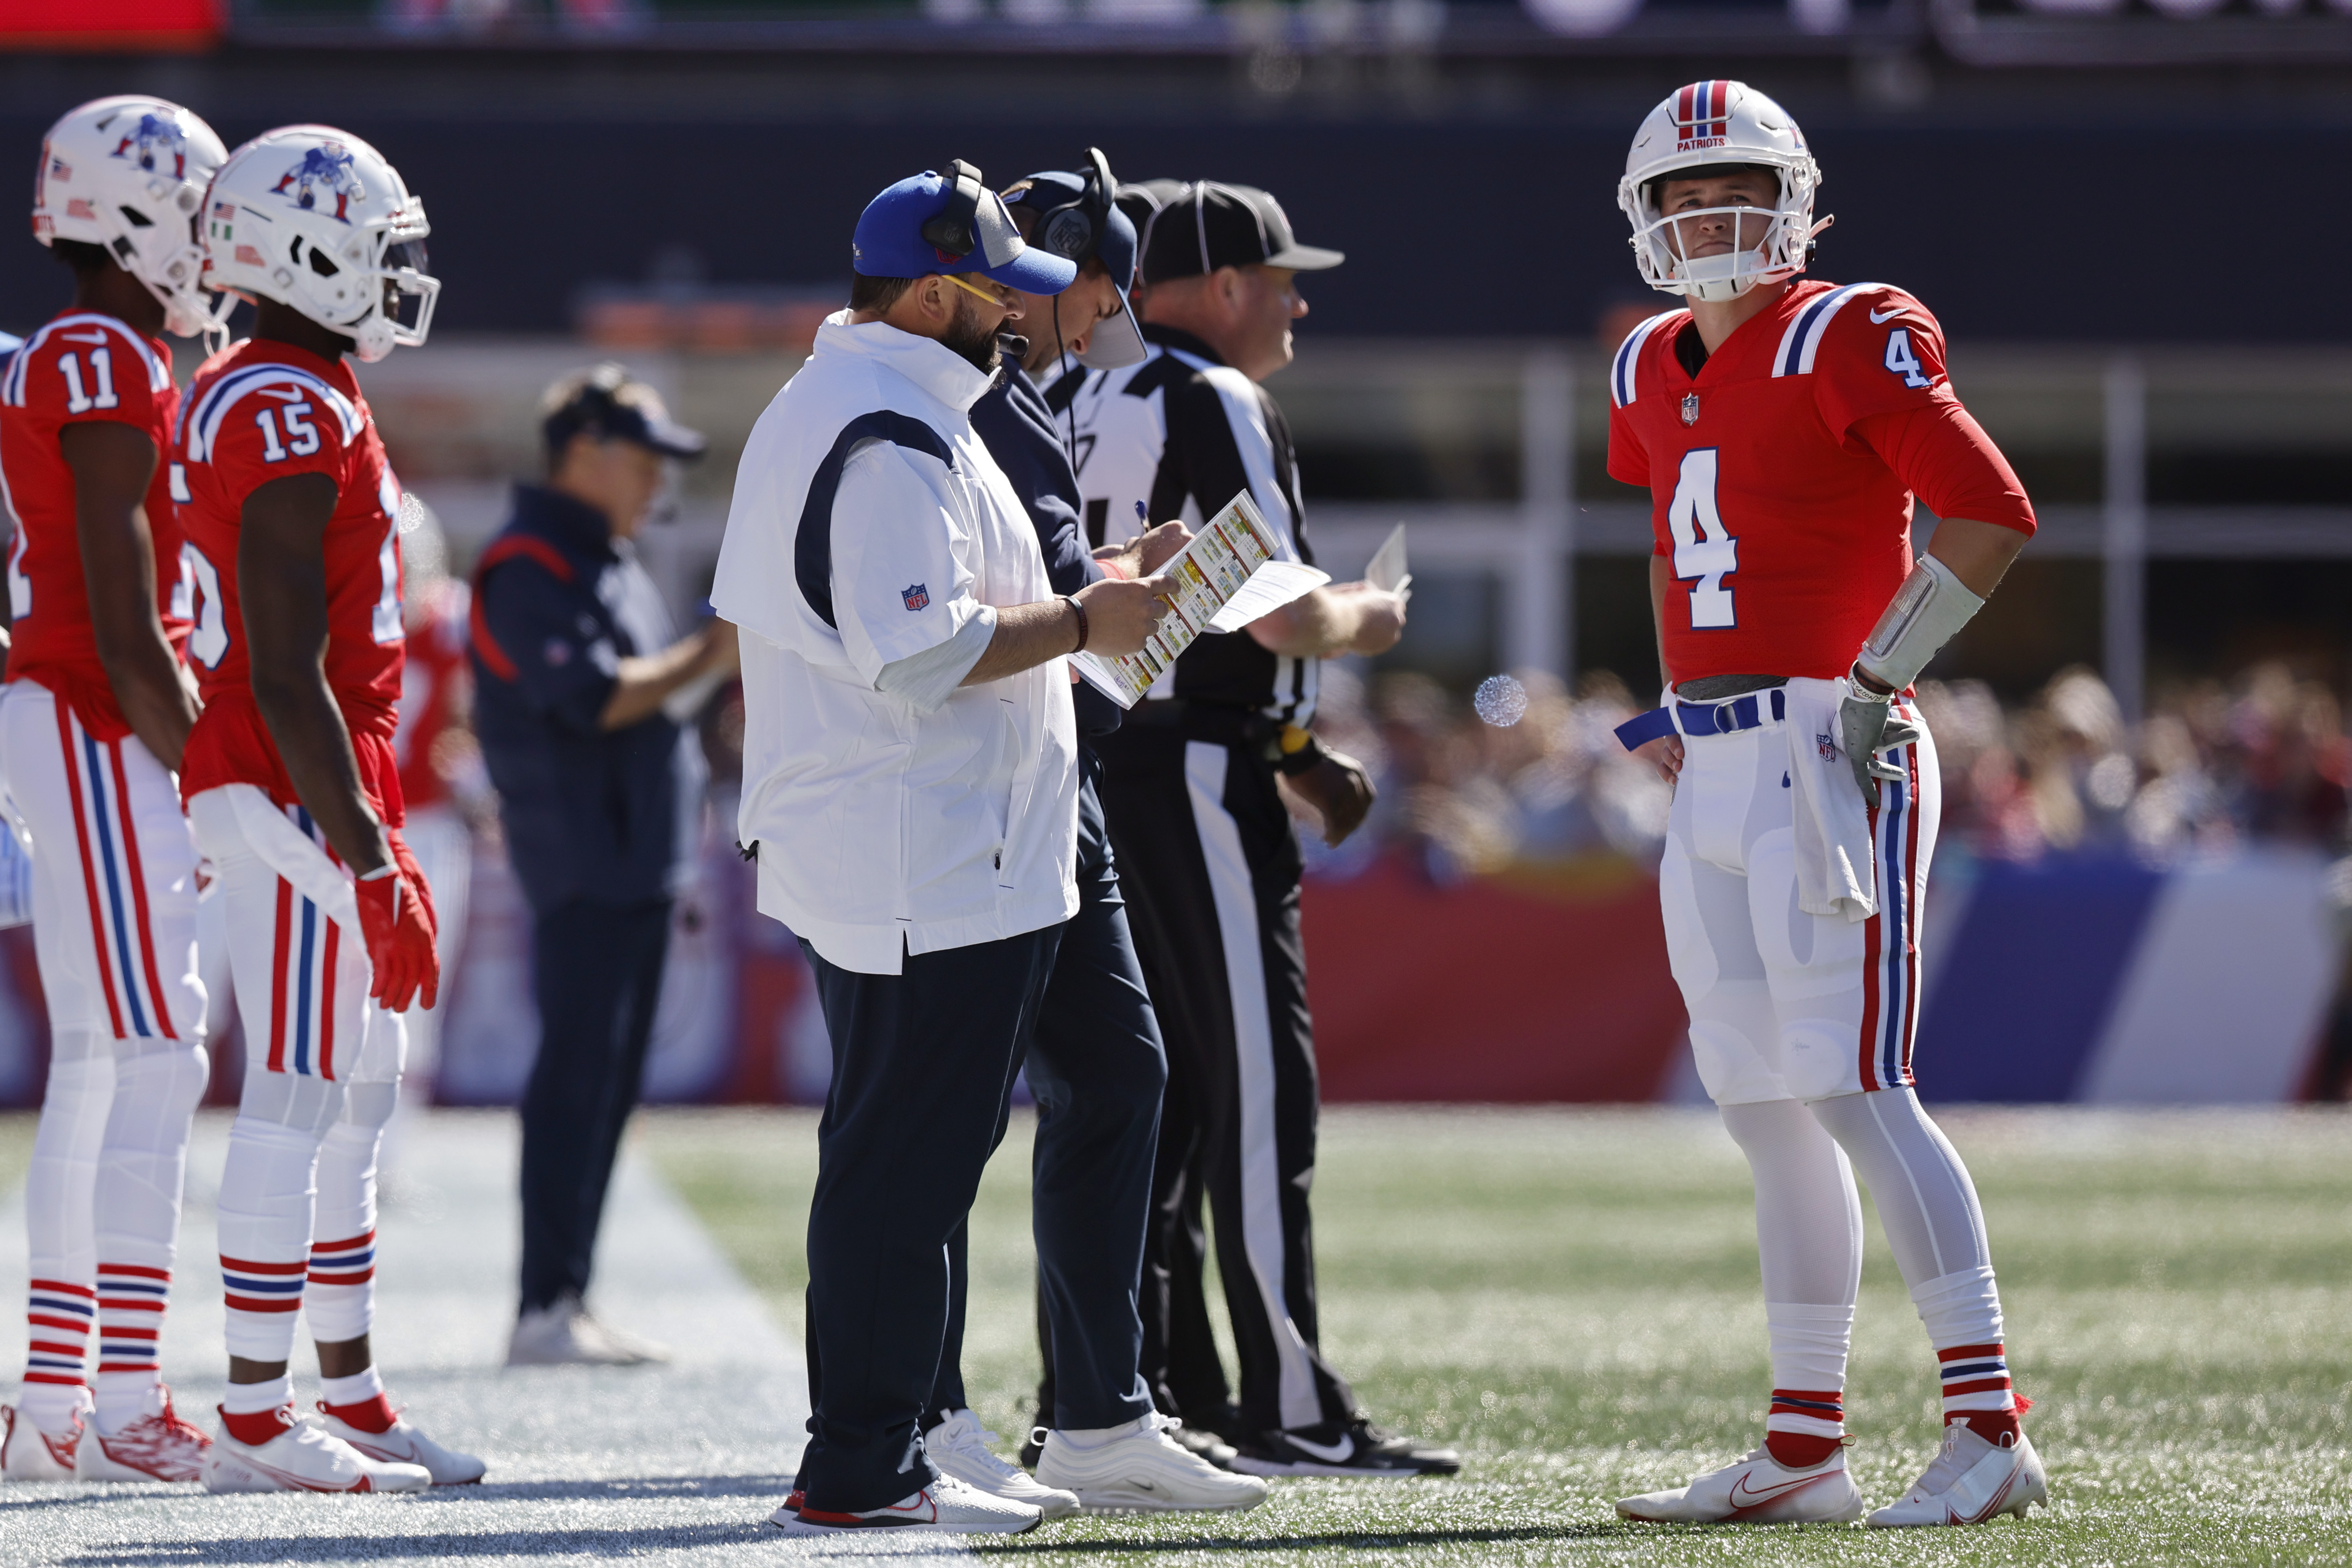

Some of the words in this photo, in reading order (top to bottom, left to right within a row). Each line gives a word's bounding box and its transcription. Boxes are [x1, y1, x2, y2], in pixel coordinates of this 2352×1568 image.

[1677, 138, 1725, 152] PATRIOTS
[1053, 227, 1079, 251] NFL
[1883, 328, 1932, 388] 4
[57, 346, 119, 414] 11
[1684, 407, 1695, 419] NFL
[255, 402, 321, 463] 15
[1668, 446, 1738, 630] 4
[907, 594, 927, 609] NFL
[1849, 677, 1855, 686] AM
[1855, 686, 1880, 701] SECOND
[1819, 742, 1834, 760] NFL
